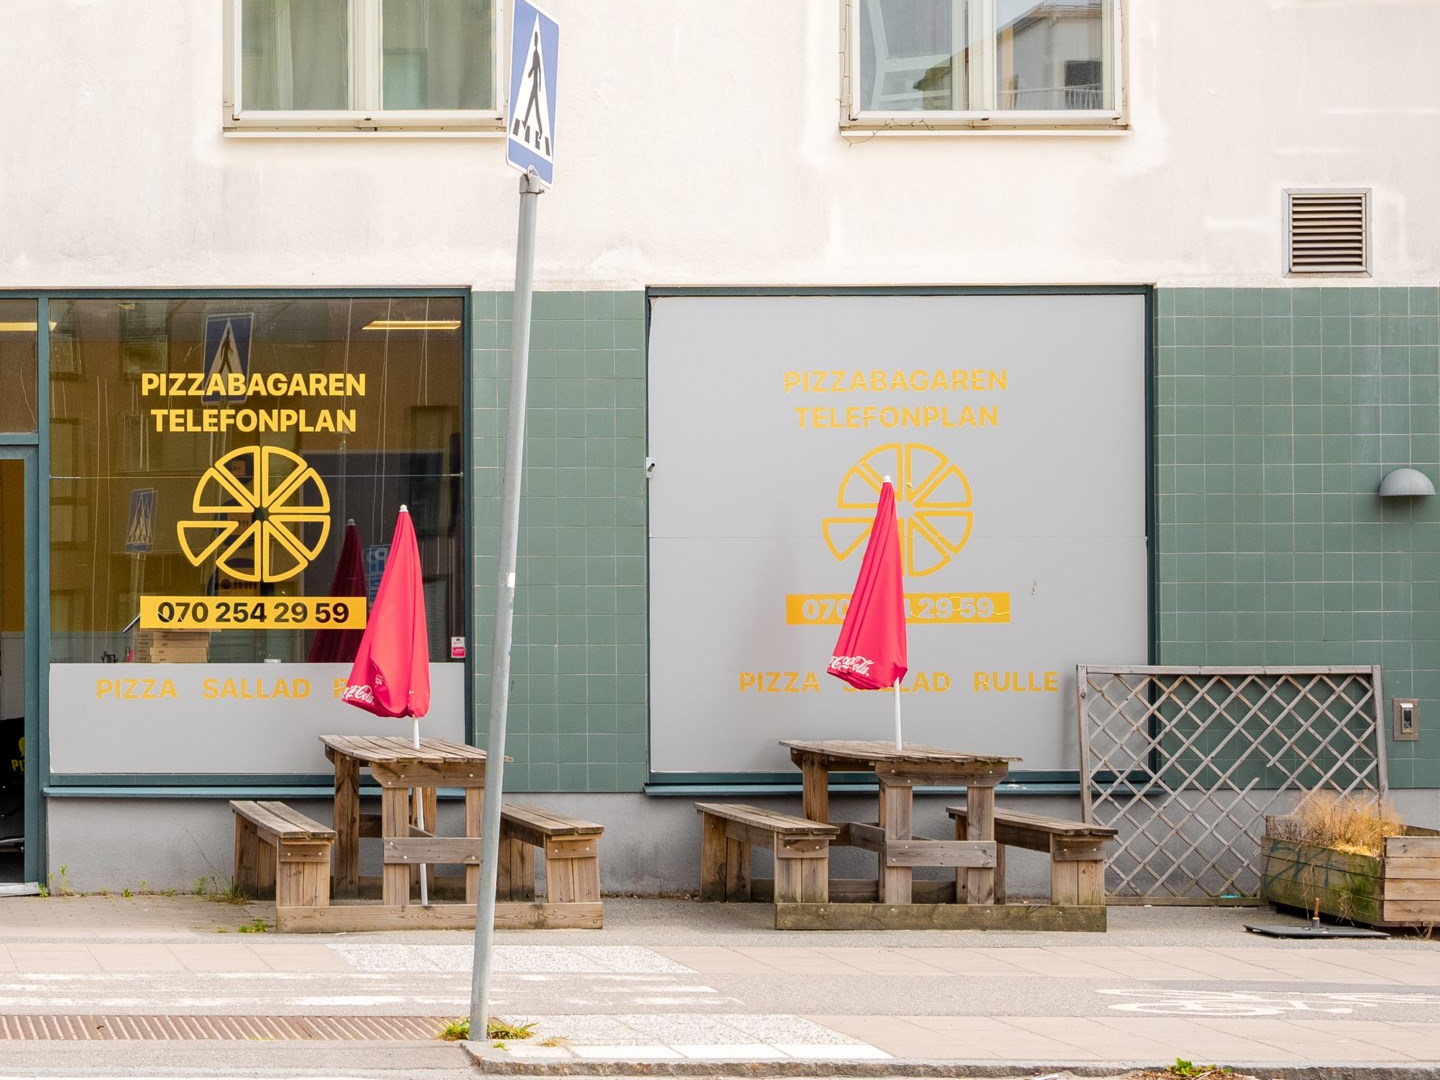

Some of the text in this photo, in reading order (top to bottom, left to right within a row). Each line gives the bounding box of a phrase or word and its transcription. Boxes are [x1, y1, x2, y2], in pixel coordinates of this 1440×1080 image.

[141, 371, 366, 397] PIZZABAGAREN
[783, 368, 1008, 393] PIZZABAGAREN
[150, 408, 357, 433] TELEFONPLAN
[793, 405, 999, 429] TELEFONPLAN
[157, 602, 350, 623] 070 254 29 59
[919, 597, 953, 619] 29
[960, 597, 994, 618] 59
[96, 677, 178, 700] PIZZA
[202, 677, 312, 700] SALLAD
[738, 671, 821, 694] PIZZA
[973, 670, 1059, 693] RULLE
